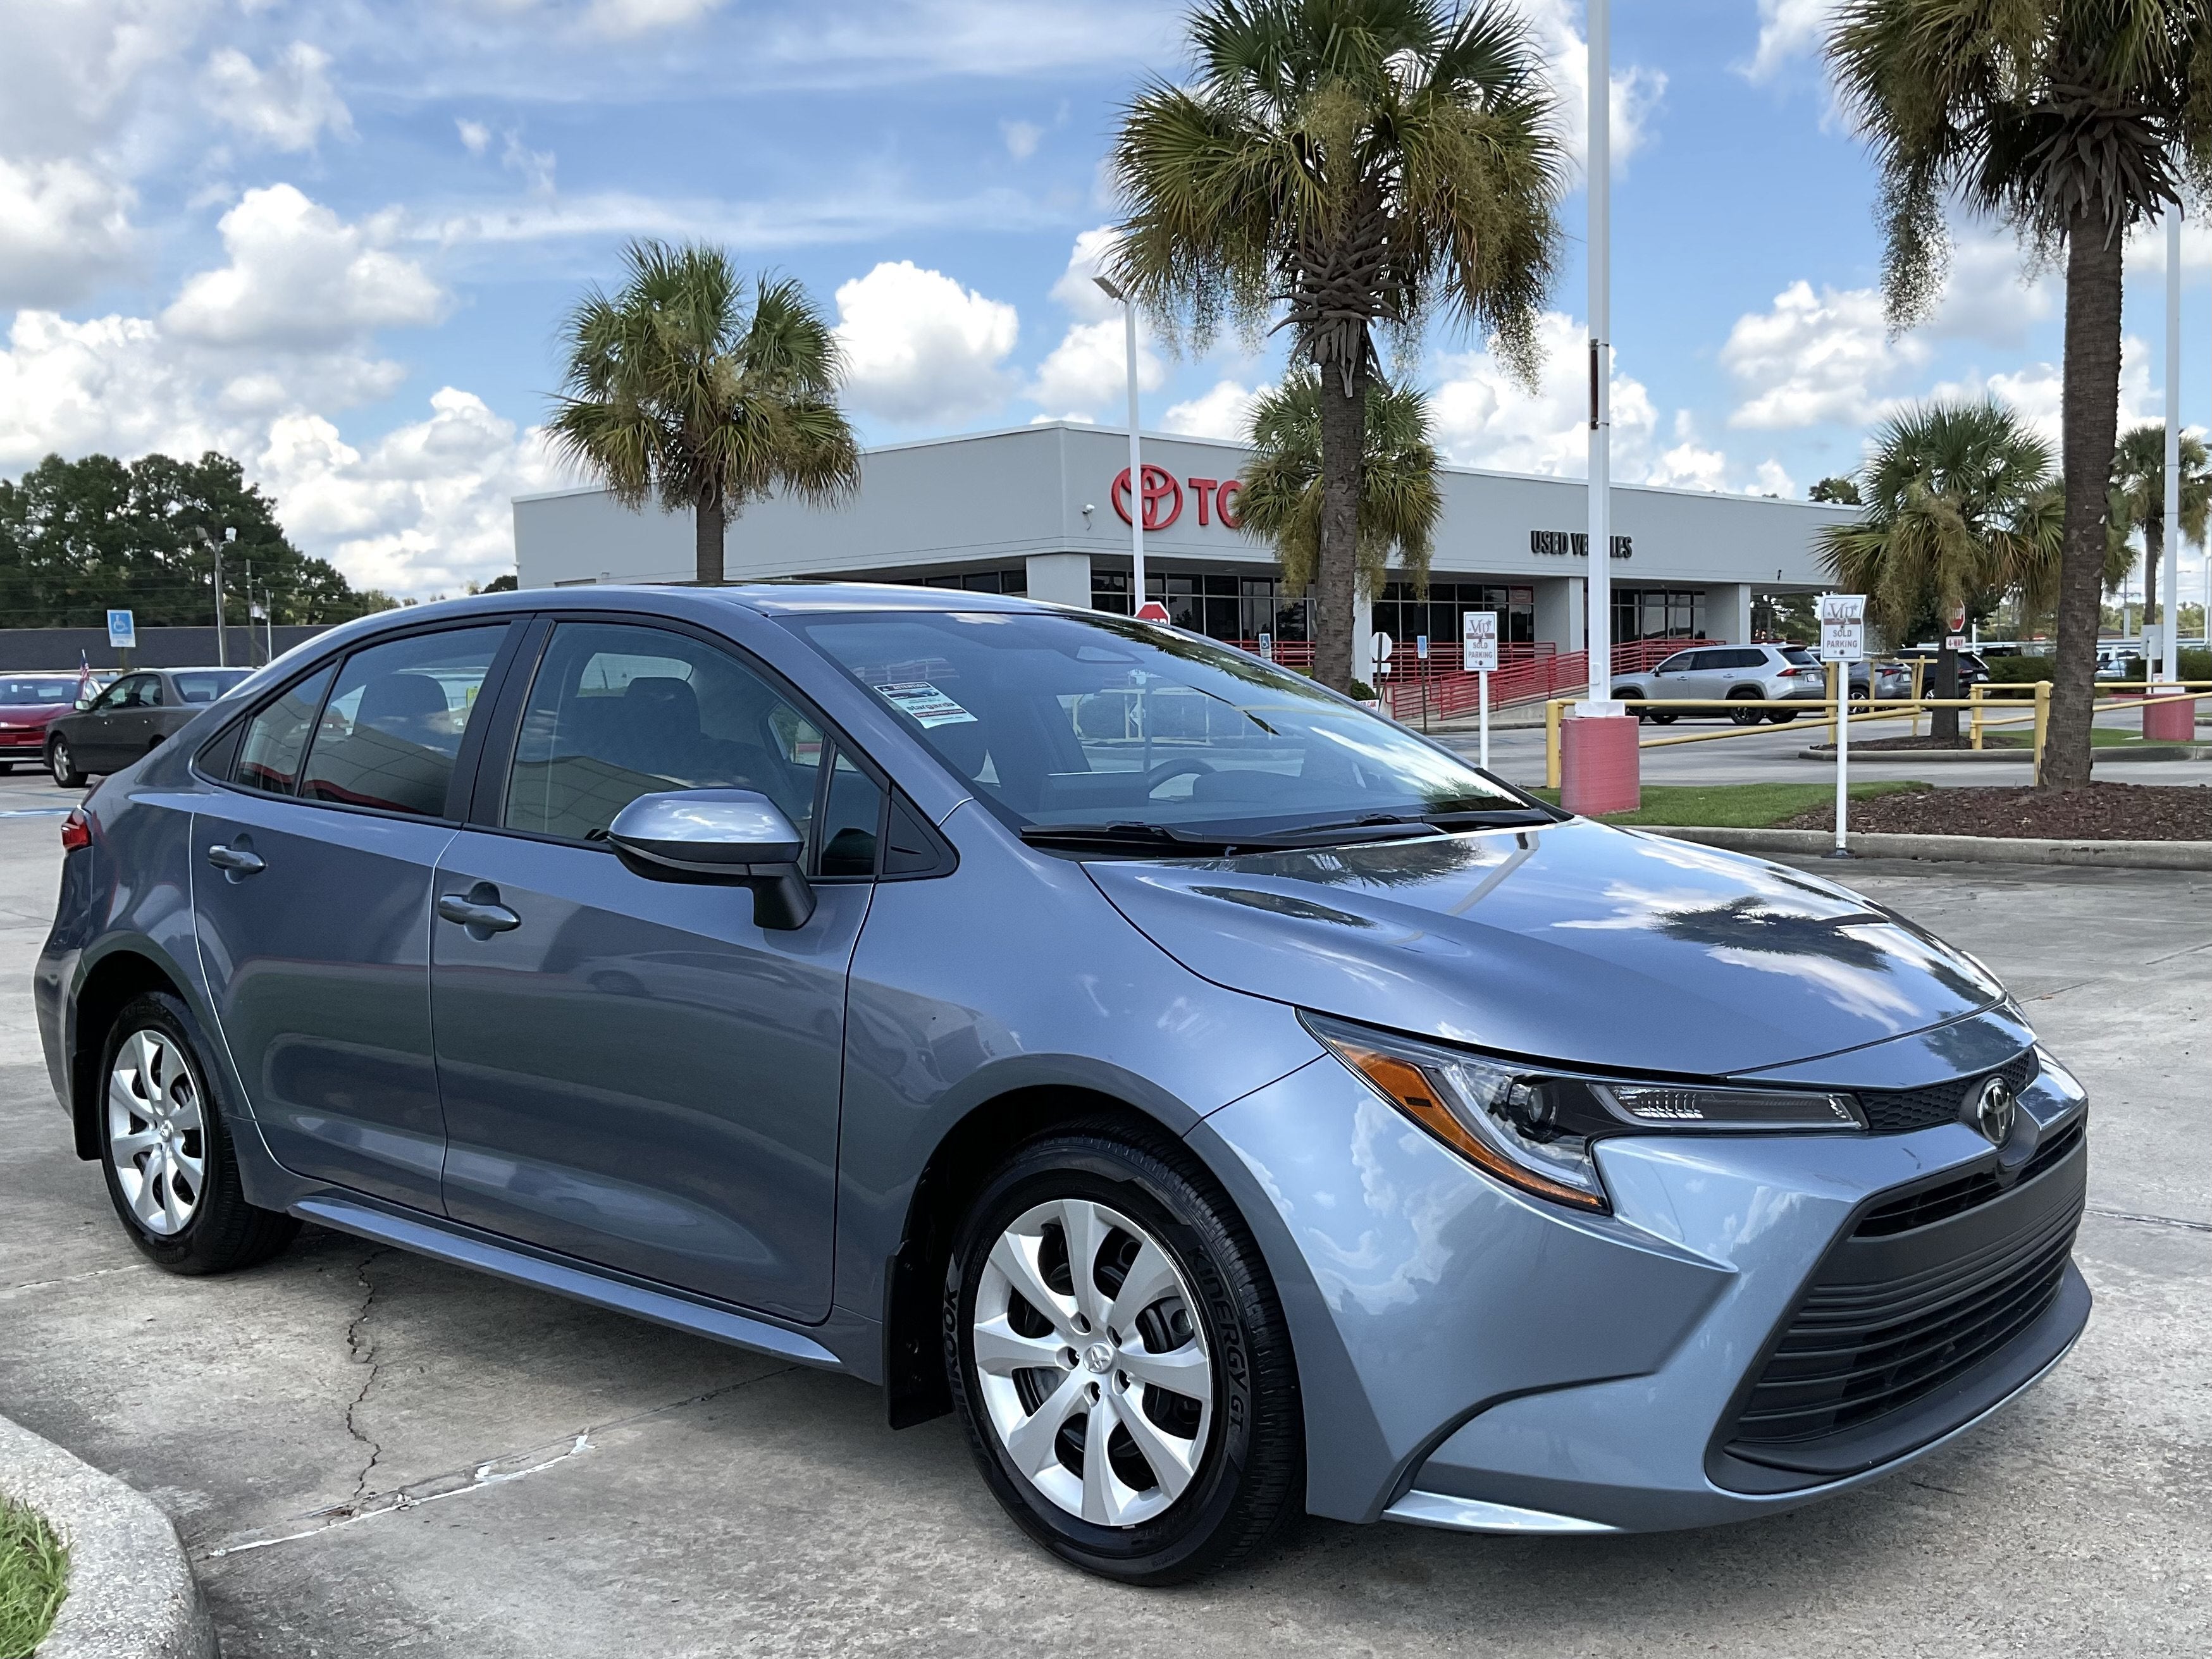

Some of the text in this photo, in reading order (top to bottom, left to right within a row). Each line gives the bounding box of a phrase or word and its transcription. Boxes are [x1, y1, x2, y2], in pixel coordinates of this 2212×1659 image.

[1531, 530, 1632, 558] USED VELES
[1833, 629, 1852, 638] SOLD
[1826, 640, 1858, 648] PARKING
[1948, 639, 1963, 647] 4-WAY
[1187, 1245, 1247, 1433] KINERGY GT
